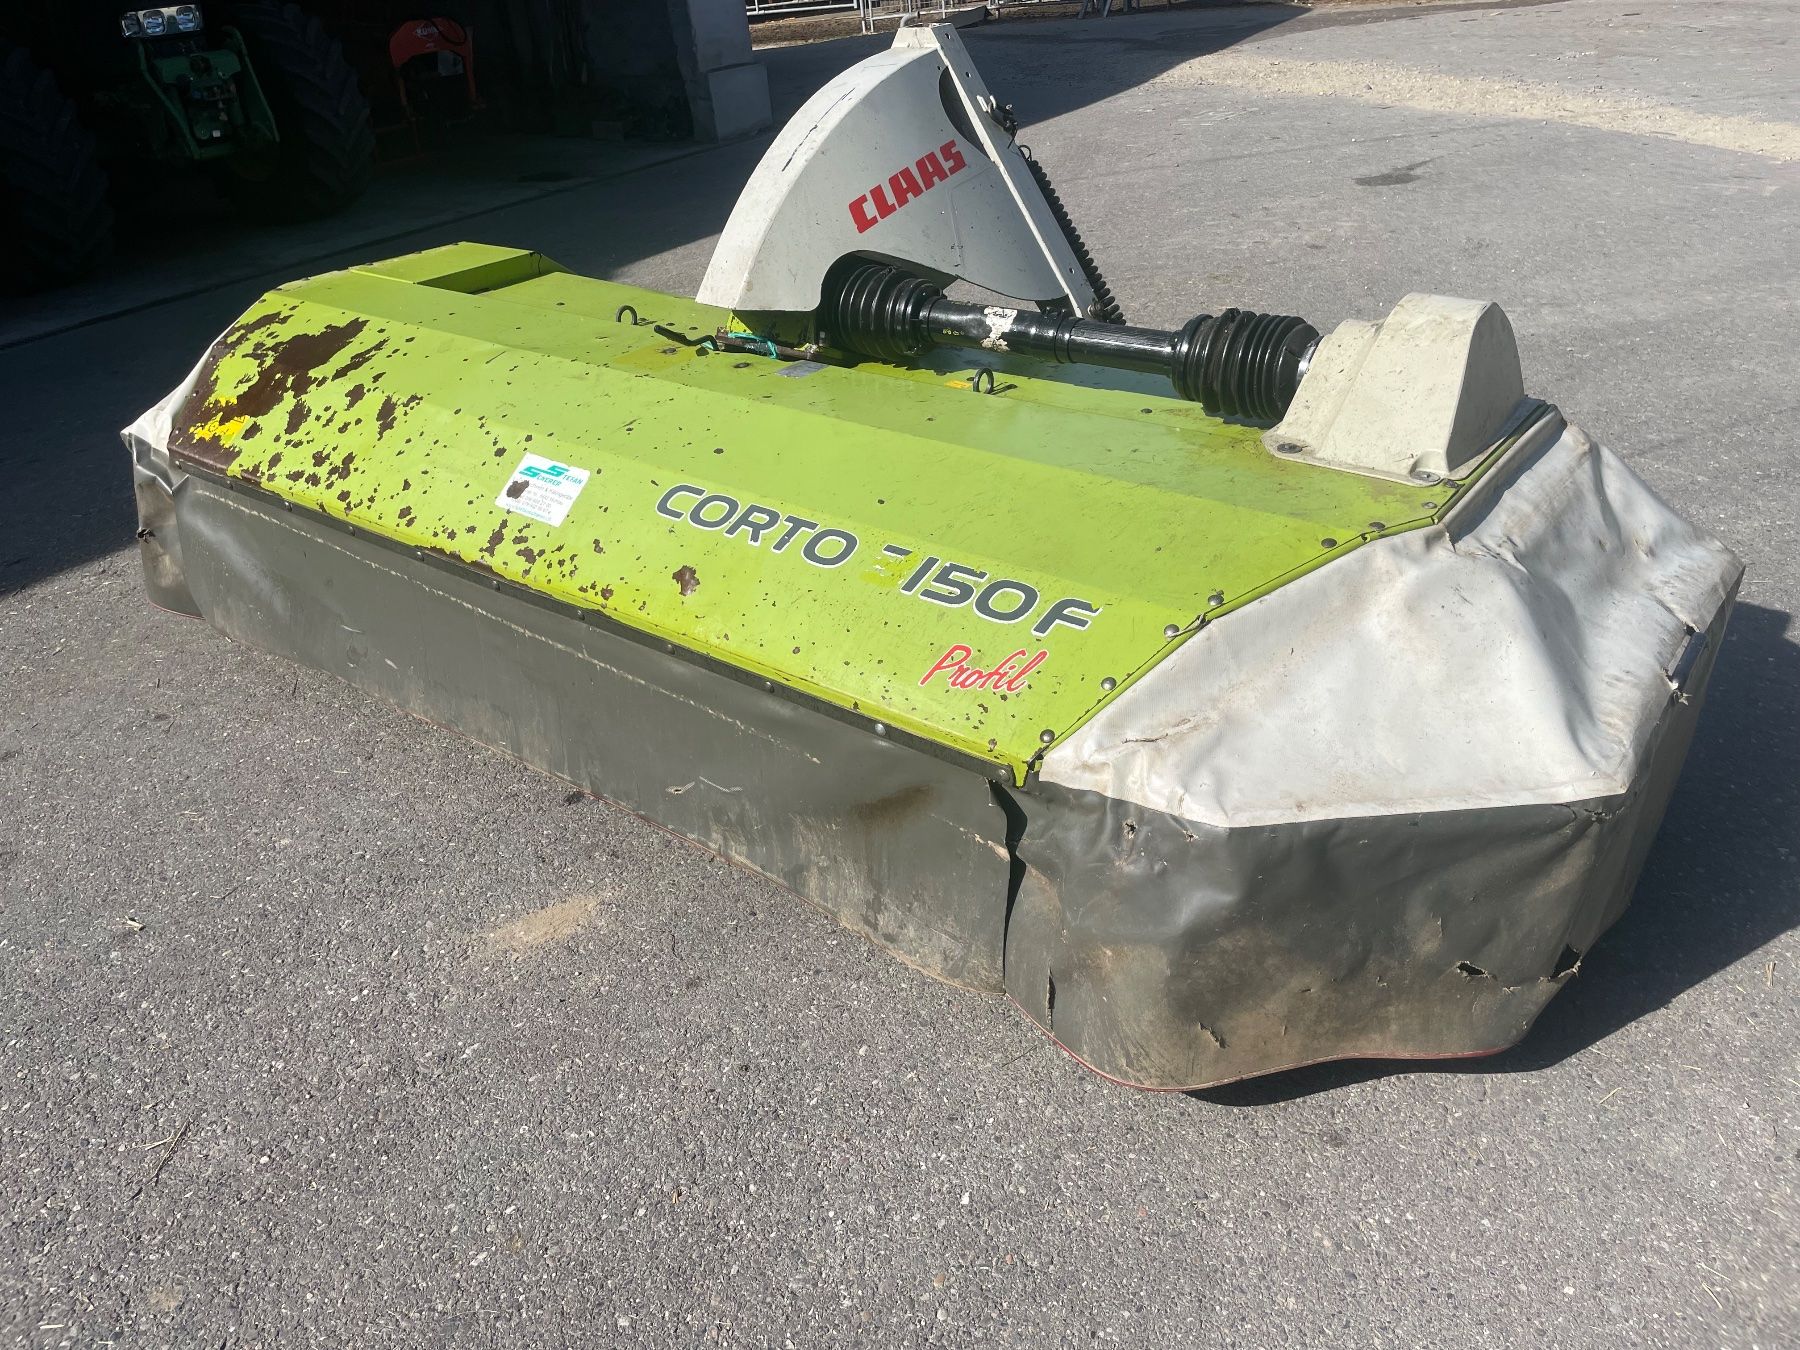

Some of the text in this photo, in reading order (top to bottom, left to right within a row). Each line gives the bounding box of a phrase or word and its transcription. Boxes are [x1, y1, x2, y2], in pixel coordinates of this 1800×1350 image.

[848, 139, 967, 234] CLAAS
[655, 483, 858, 568] CORTO
[918, 644, 1049, 693] Profil
